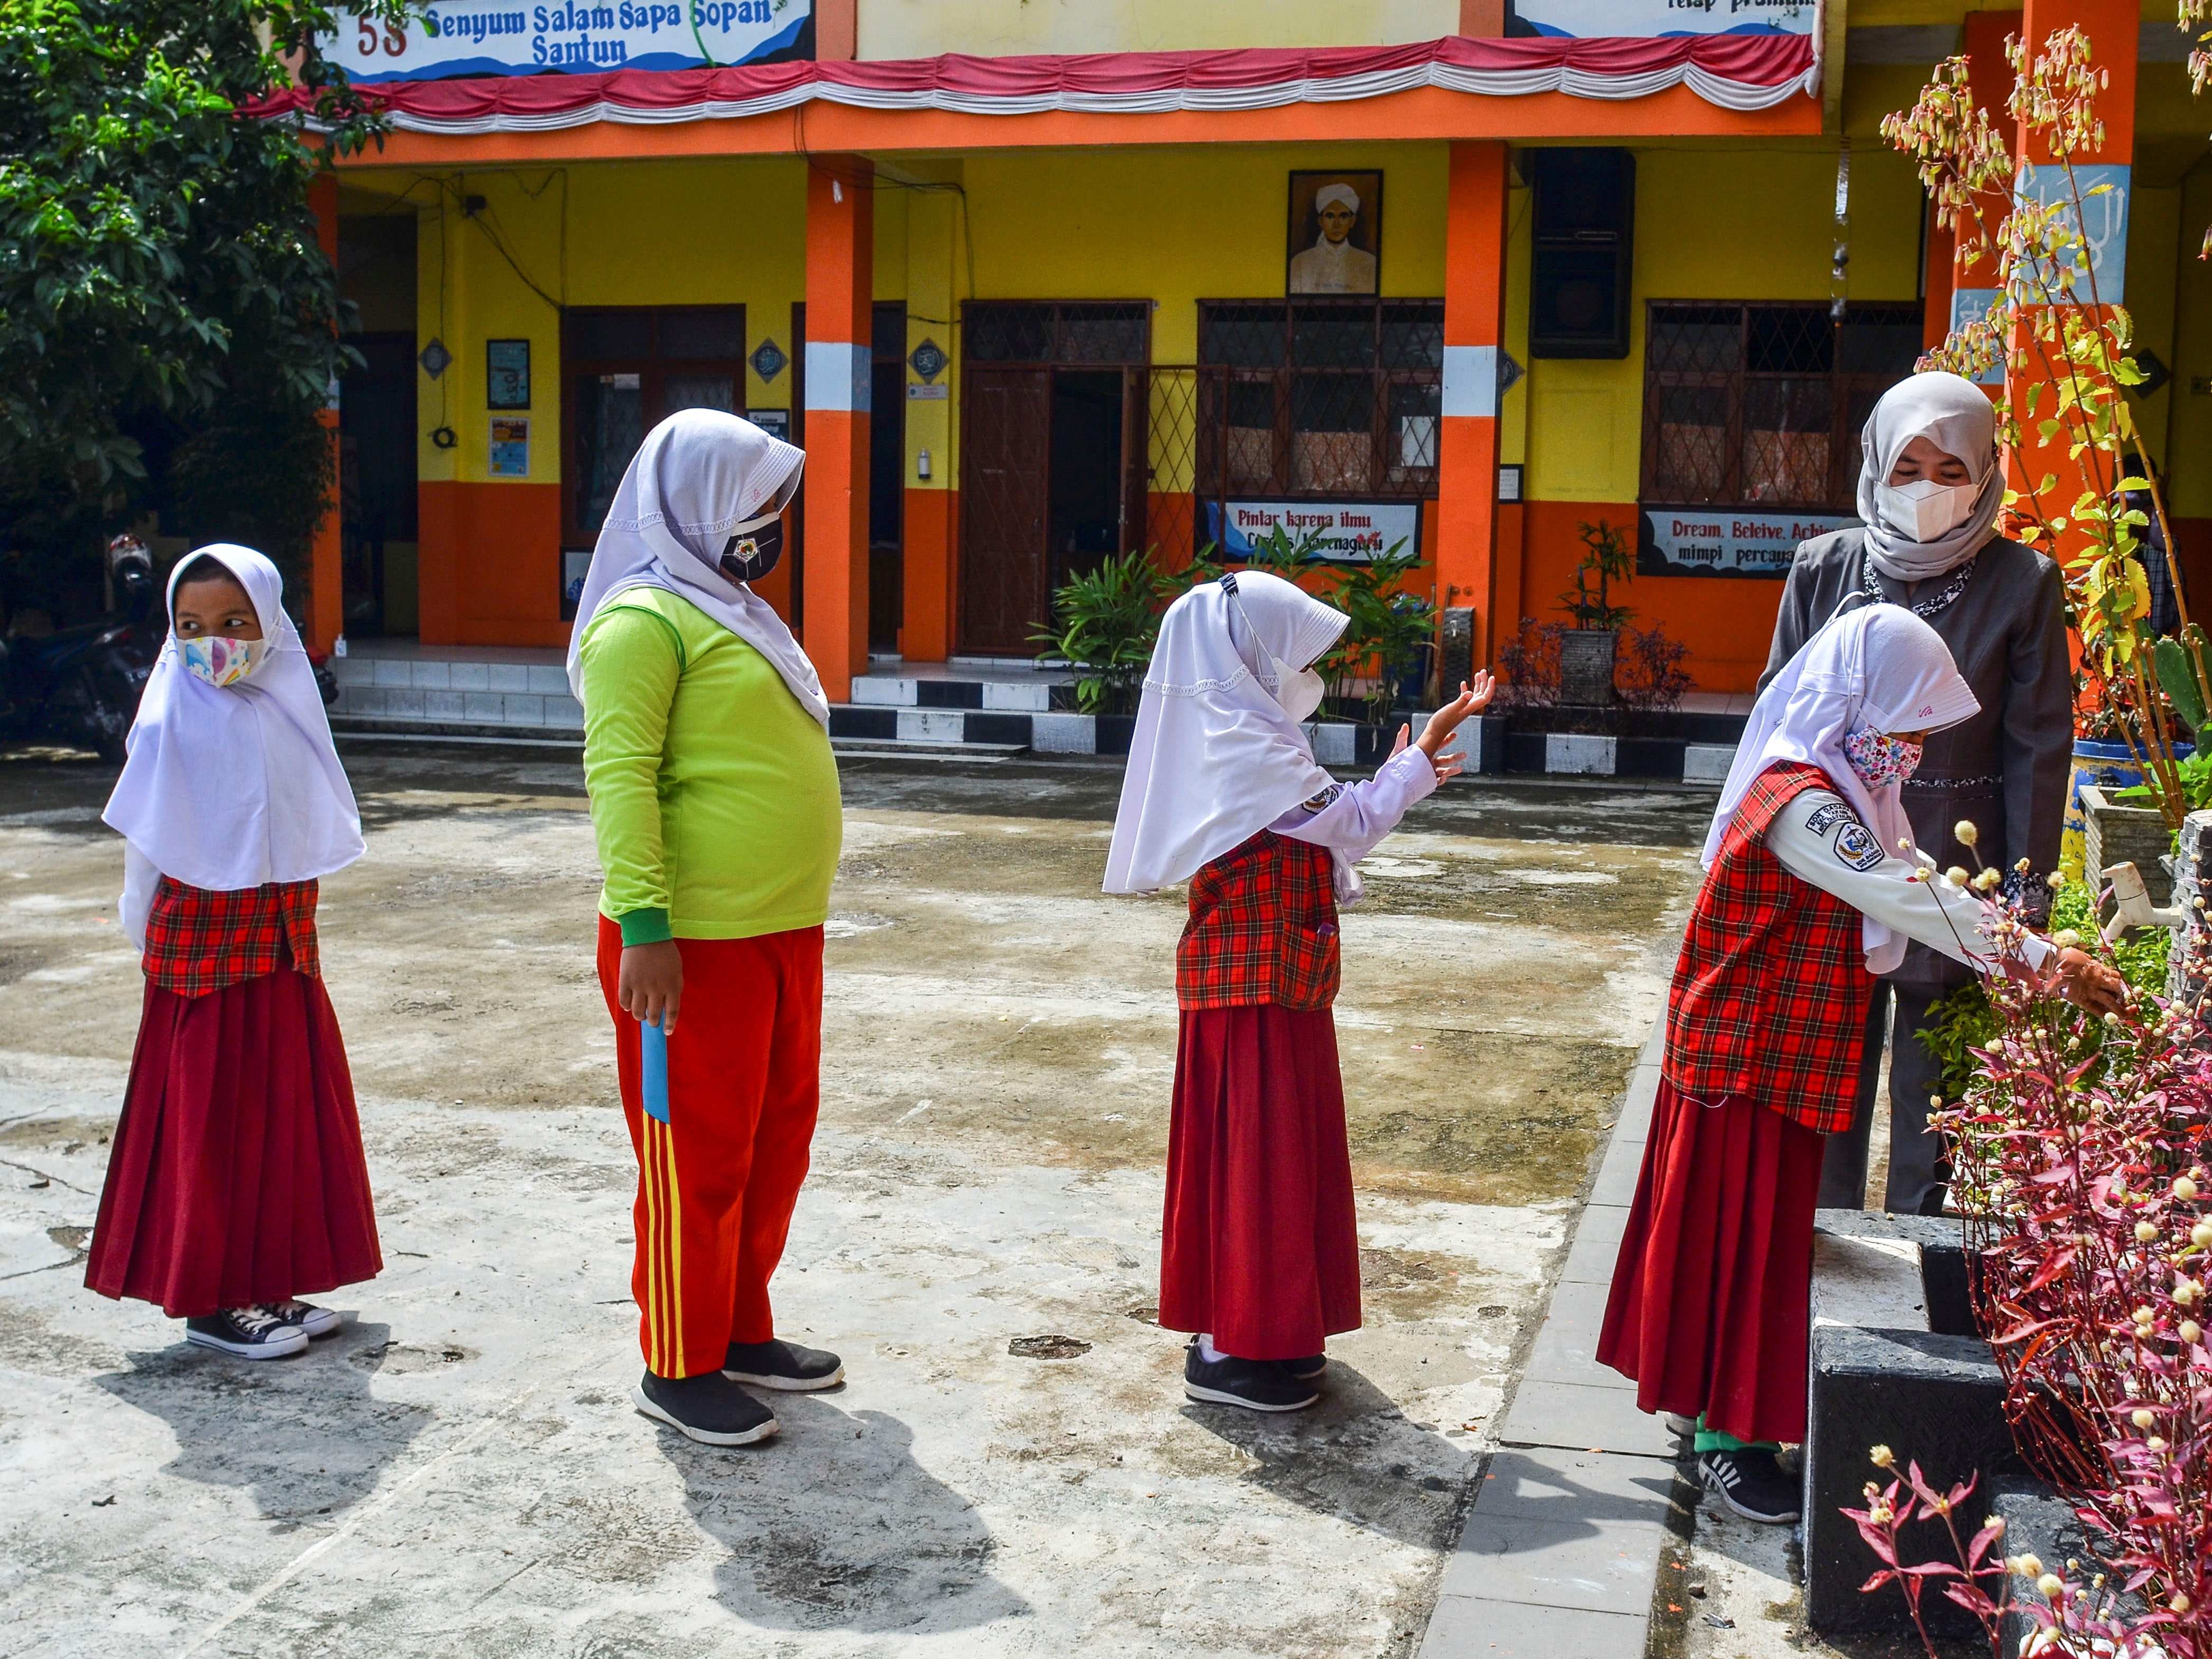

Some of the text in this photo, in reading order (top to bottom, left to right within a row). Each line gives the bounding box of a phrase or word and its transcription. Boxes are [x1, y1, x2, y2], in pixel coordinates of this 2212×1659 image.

[425, 0, 772, 44] Senyum Salam Sapa Sopan
[532, 33, 628, 64] Santun
[1238, 509, 1371, 528] Pintar karena ilmu
[1672, 520, 1725, 538] Dream.
[1732, 521, 1786, 539] Beleive.
[1678, 545, 1795, 568] mimpi percaya
[1810, 813, 1822, 826] SDN
